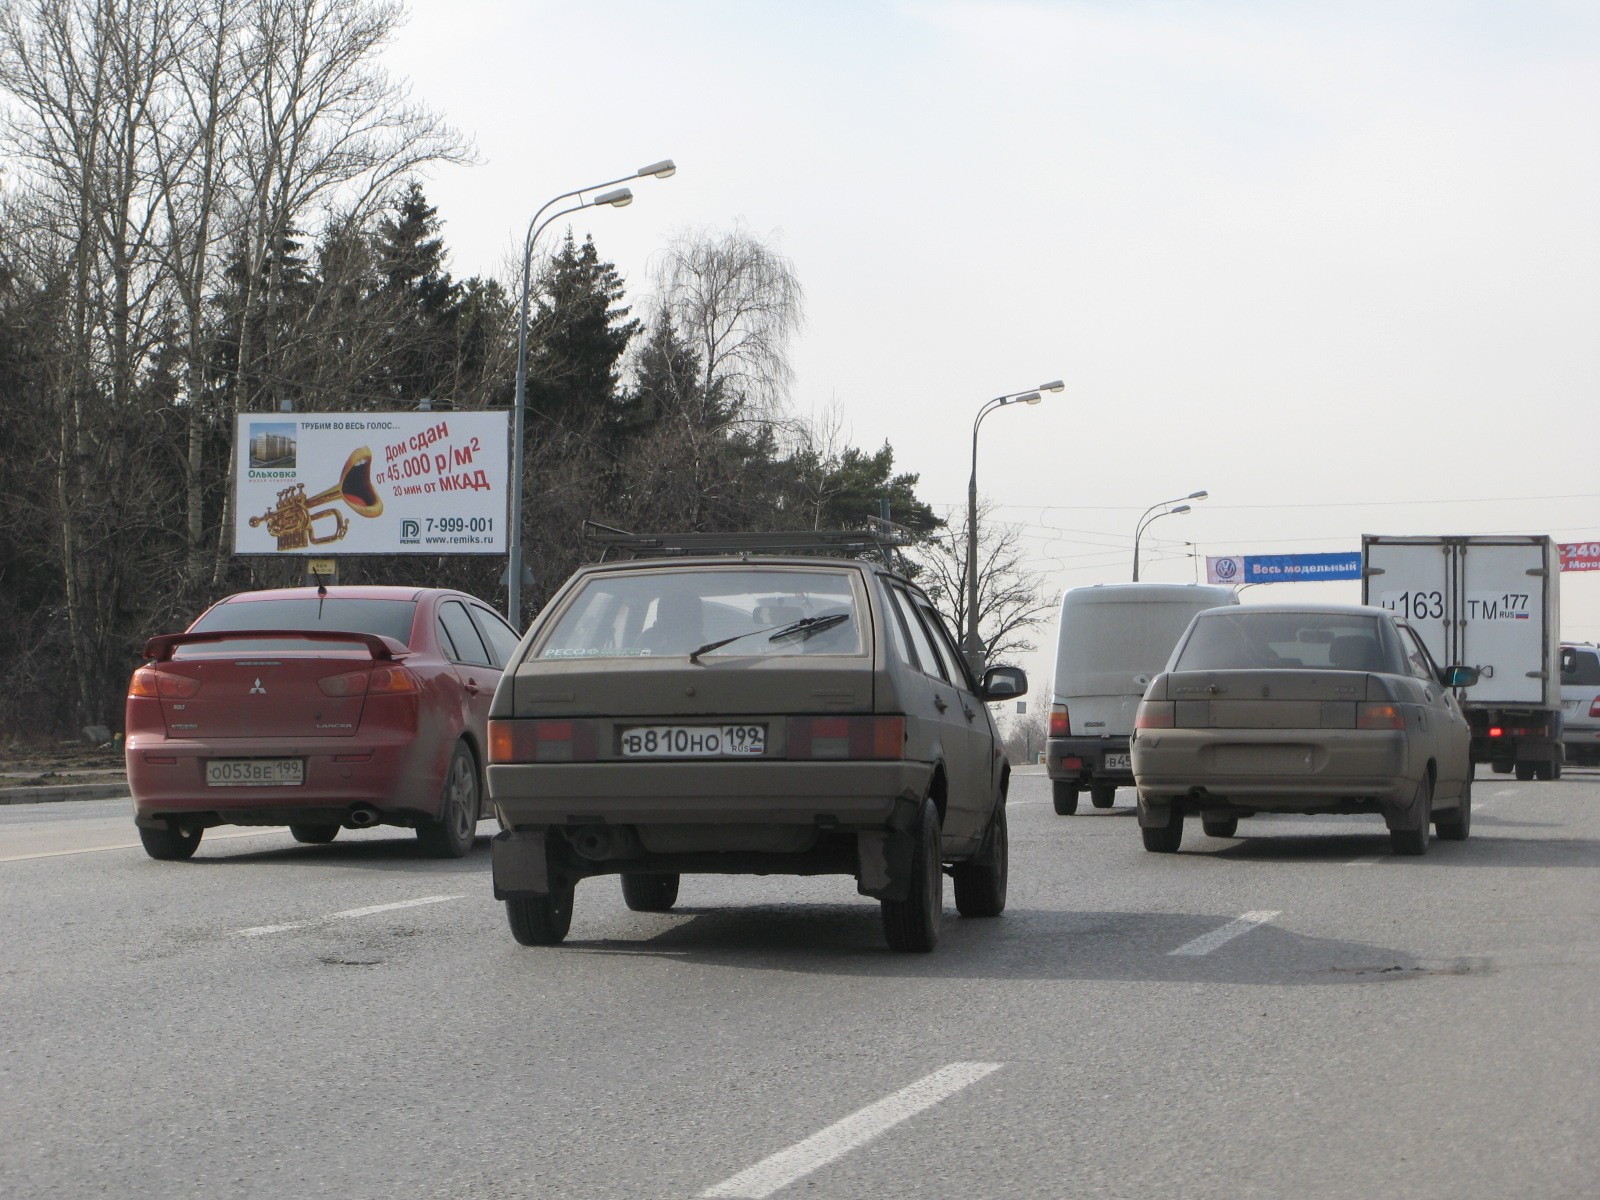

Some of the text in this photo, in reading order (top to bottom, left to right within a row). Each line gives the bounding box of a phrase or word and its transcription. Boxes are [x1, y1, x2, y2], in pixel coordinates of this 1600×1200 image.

[301, 422, 331, 430] ТРУБИМ
[333, 422, 344, 430] ВО
[345, 422, 365, 430] ВЕСЬ
[385, 421, 449, 463] Дом сдан
[248, 470, 297, 478] Ольховка
[376, 472, 385, 484] от
[387, 453, 431, 481] 45.000
[392, 469, 491, 496] 20 мин от МКАД
[425, 517, 493, 532] 7-999-001
[425, 535, 494, 544] www.remiks.ru
[1253, 561, 1357, 574] Весь модельный
[1467, 600, 1497, 619] ТМ
[1501, 594, 1529, 610] 177
[725, 727, 758, 746] 199
[276, 762, 299, 774] 199
